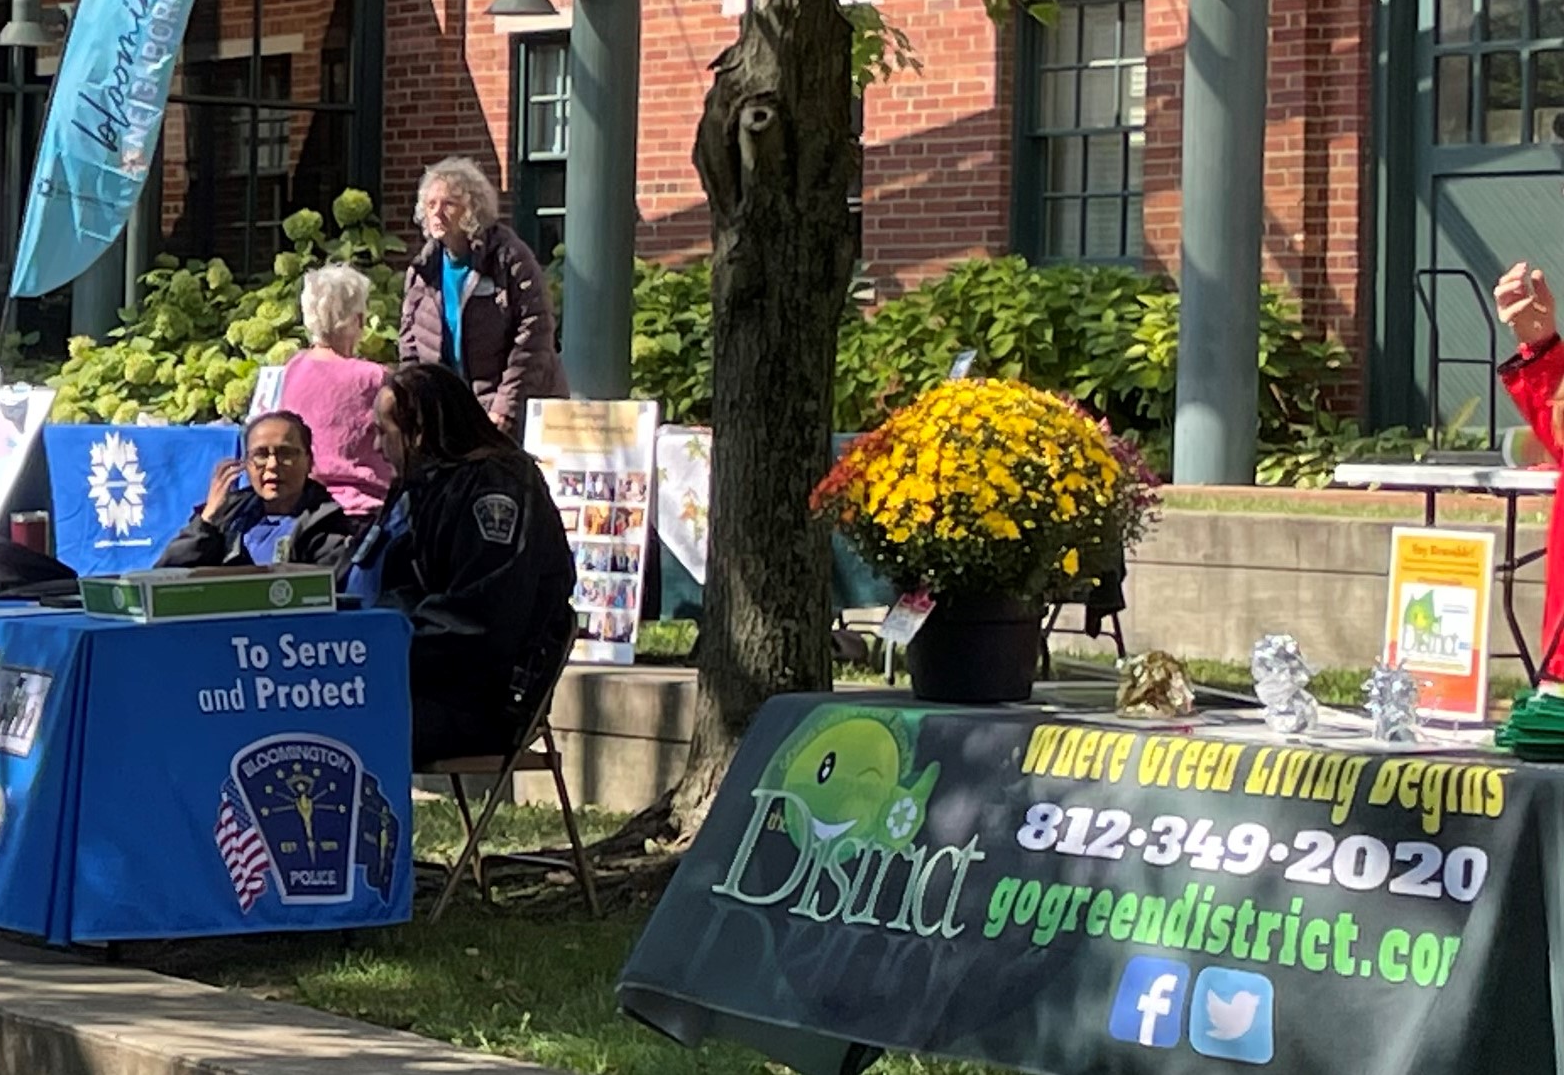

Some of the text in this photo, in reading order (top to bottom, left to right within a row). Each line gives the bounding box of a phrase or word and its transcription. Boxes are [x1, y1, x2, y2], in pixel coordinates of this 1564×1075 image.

[231, 633, 367, 669] To Serve
[198, 676, 366, 712] and Protect
[241, 744, 352, 778] BLOOMINGTON
[1022, 725, 1515, 834] Where Green Living Begins
[289, 870, 337, 886] POLICE
[712, 789, 986, 939] District
